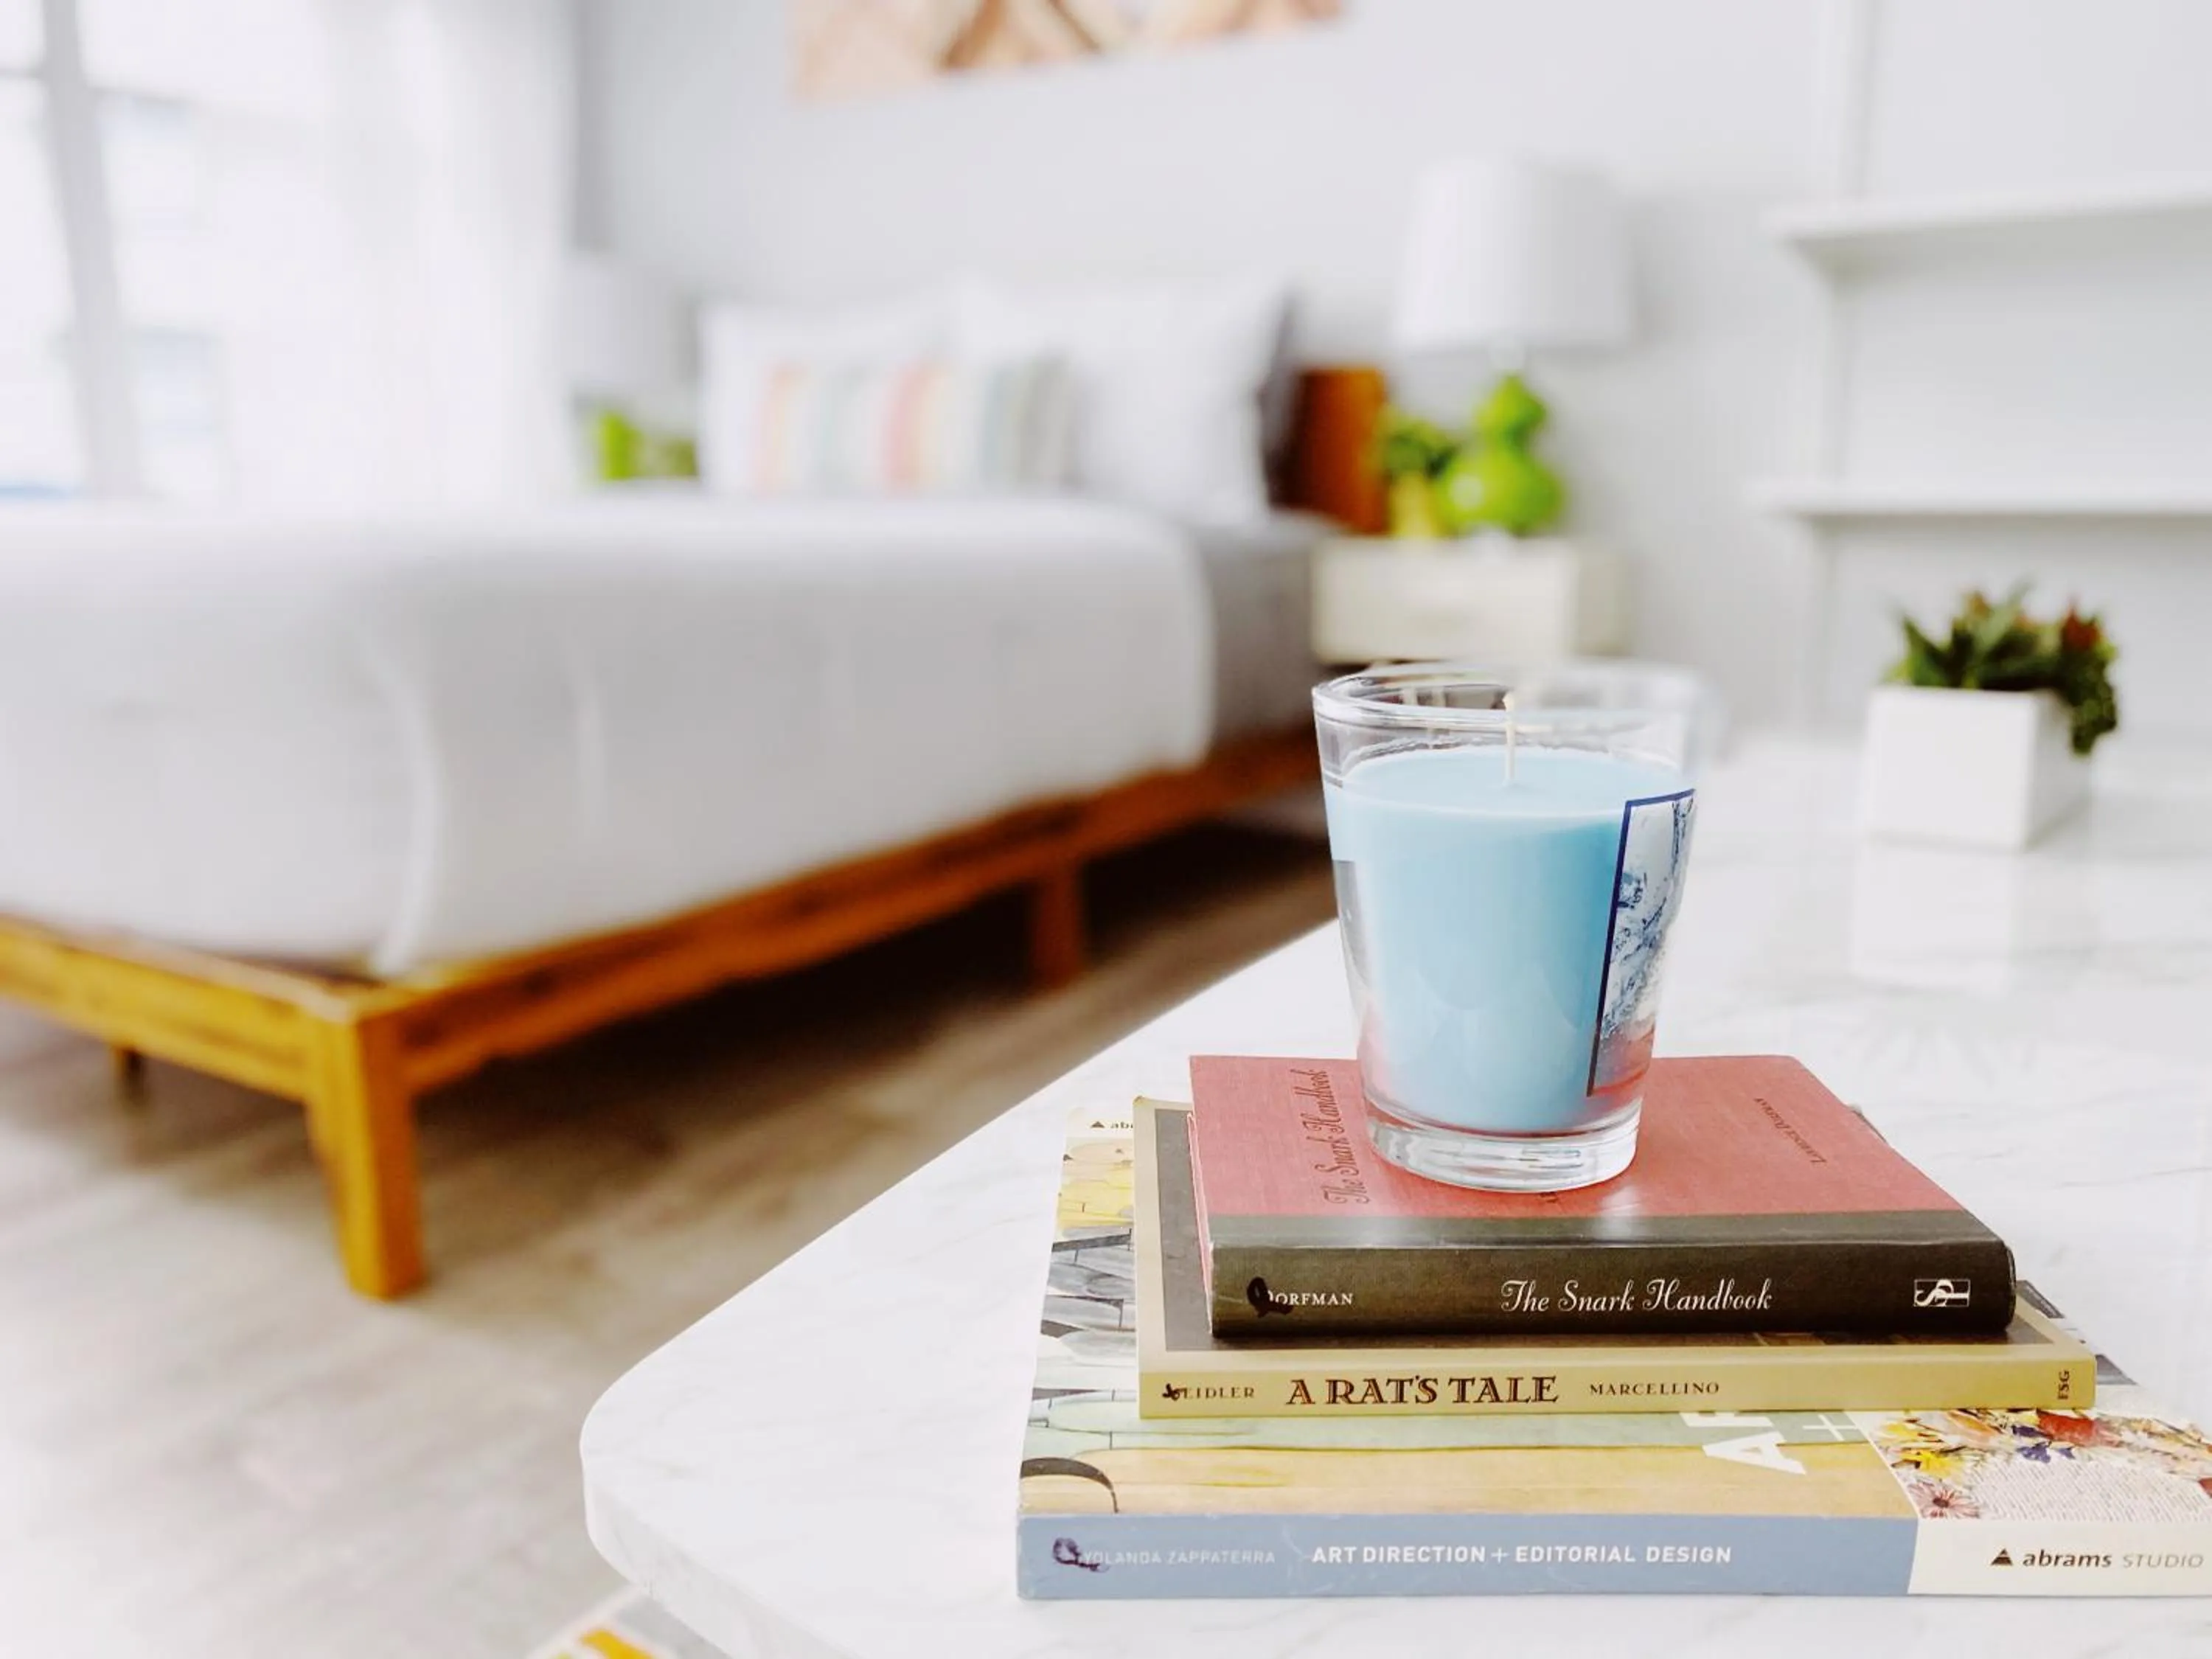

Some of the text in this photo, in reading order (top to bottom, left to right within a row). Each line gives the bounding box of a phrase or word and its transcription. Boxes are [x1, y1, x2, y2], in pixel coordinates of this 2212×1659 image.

[1290, 1068, 1370, 1204] The Snark Handbook
[1500, 1277, 1773, 1312] The Snark Handbook
[1171, 1386, 1255, 1399] EIDLER
[1286, 1375, 1559, 1405] A RAT'S TALE
[1589, 1381, 1720, 1396] MARCELLINO
[2057, 1370, 2070, 1400] FSG
[1167, 1551, 1276, 1565] ZAPPATERRA
[1312, 1545, 1357, 1564] ART
[1363, 1545, 1486, 1563] DIRECTION
[1515, 1545, 1636, 1563] EDITORIAL
[1645, 1545, 1731, 1563] DESIGN
[2023, 1548, 2205, 1568] abrams STUDIO
